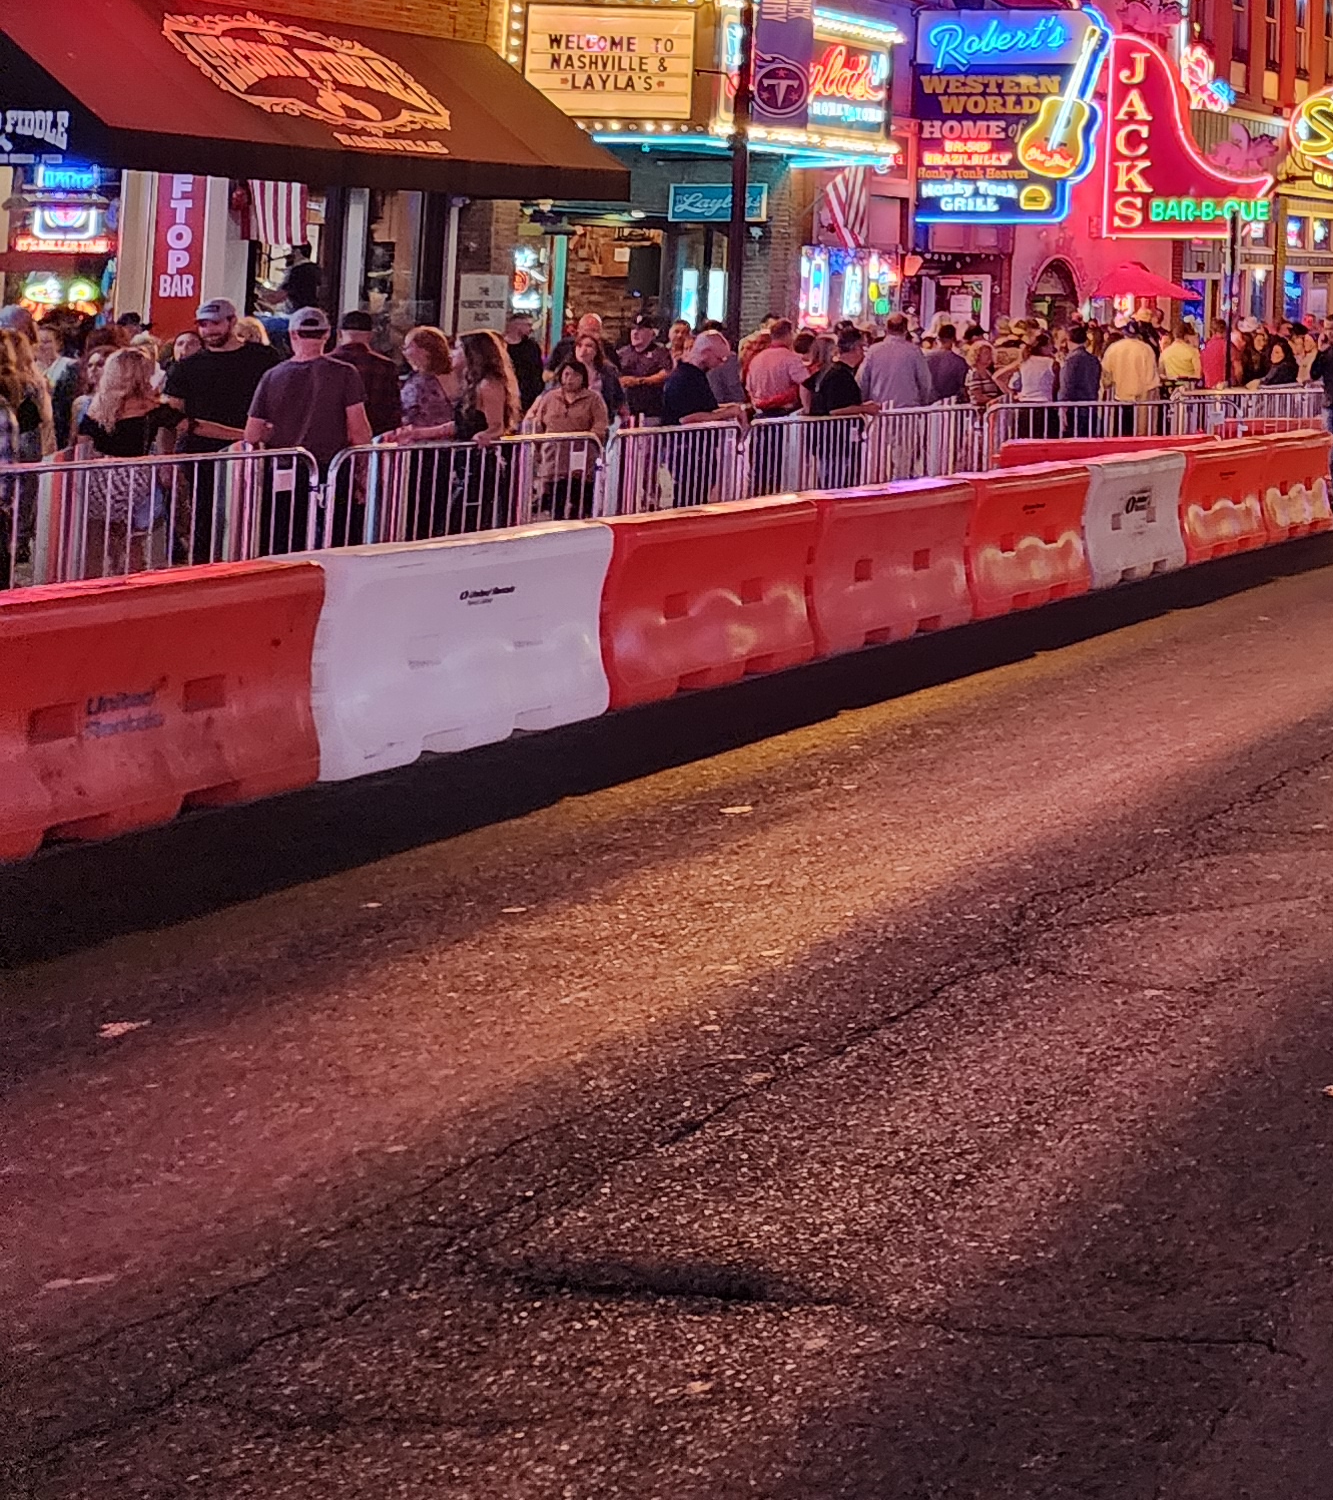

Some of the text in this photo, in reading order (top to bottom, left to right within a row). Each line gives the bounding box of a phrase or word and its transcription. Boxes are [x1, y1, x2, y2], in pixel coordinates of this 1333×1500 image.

[548, 33, 674, 53] WELCOME TO
[929, 16, 1067, 71] Robert's
[550, 54, 668, 73] NASHVILLE &
[808, 45, 885, 103] yla's
[571, 74, 653, 92] LAYLA'S
[919, 73, 1062, 95] WESTERN
[938, 95, 1042, 115] WORLD
[5, 110, 71, 151] FIDDLE
[921, 120, 1006, 140] HOME
[1112, 52, 1153, 229] JACKS
[1313, 171, 1333, 187] ON
[939, 197, 1000, 212] GRILL
[166, 174, 193, 275] FTOP
[158, 274, 194, 298] BAR
